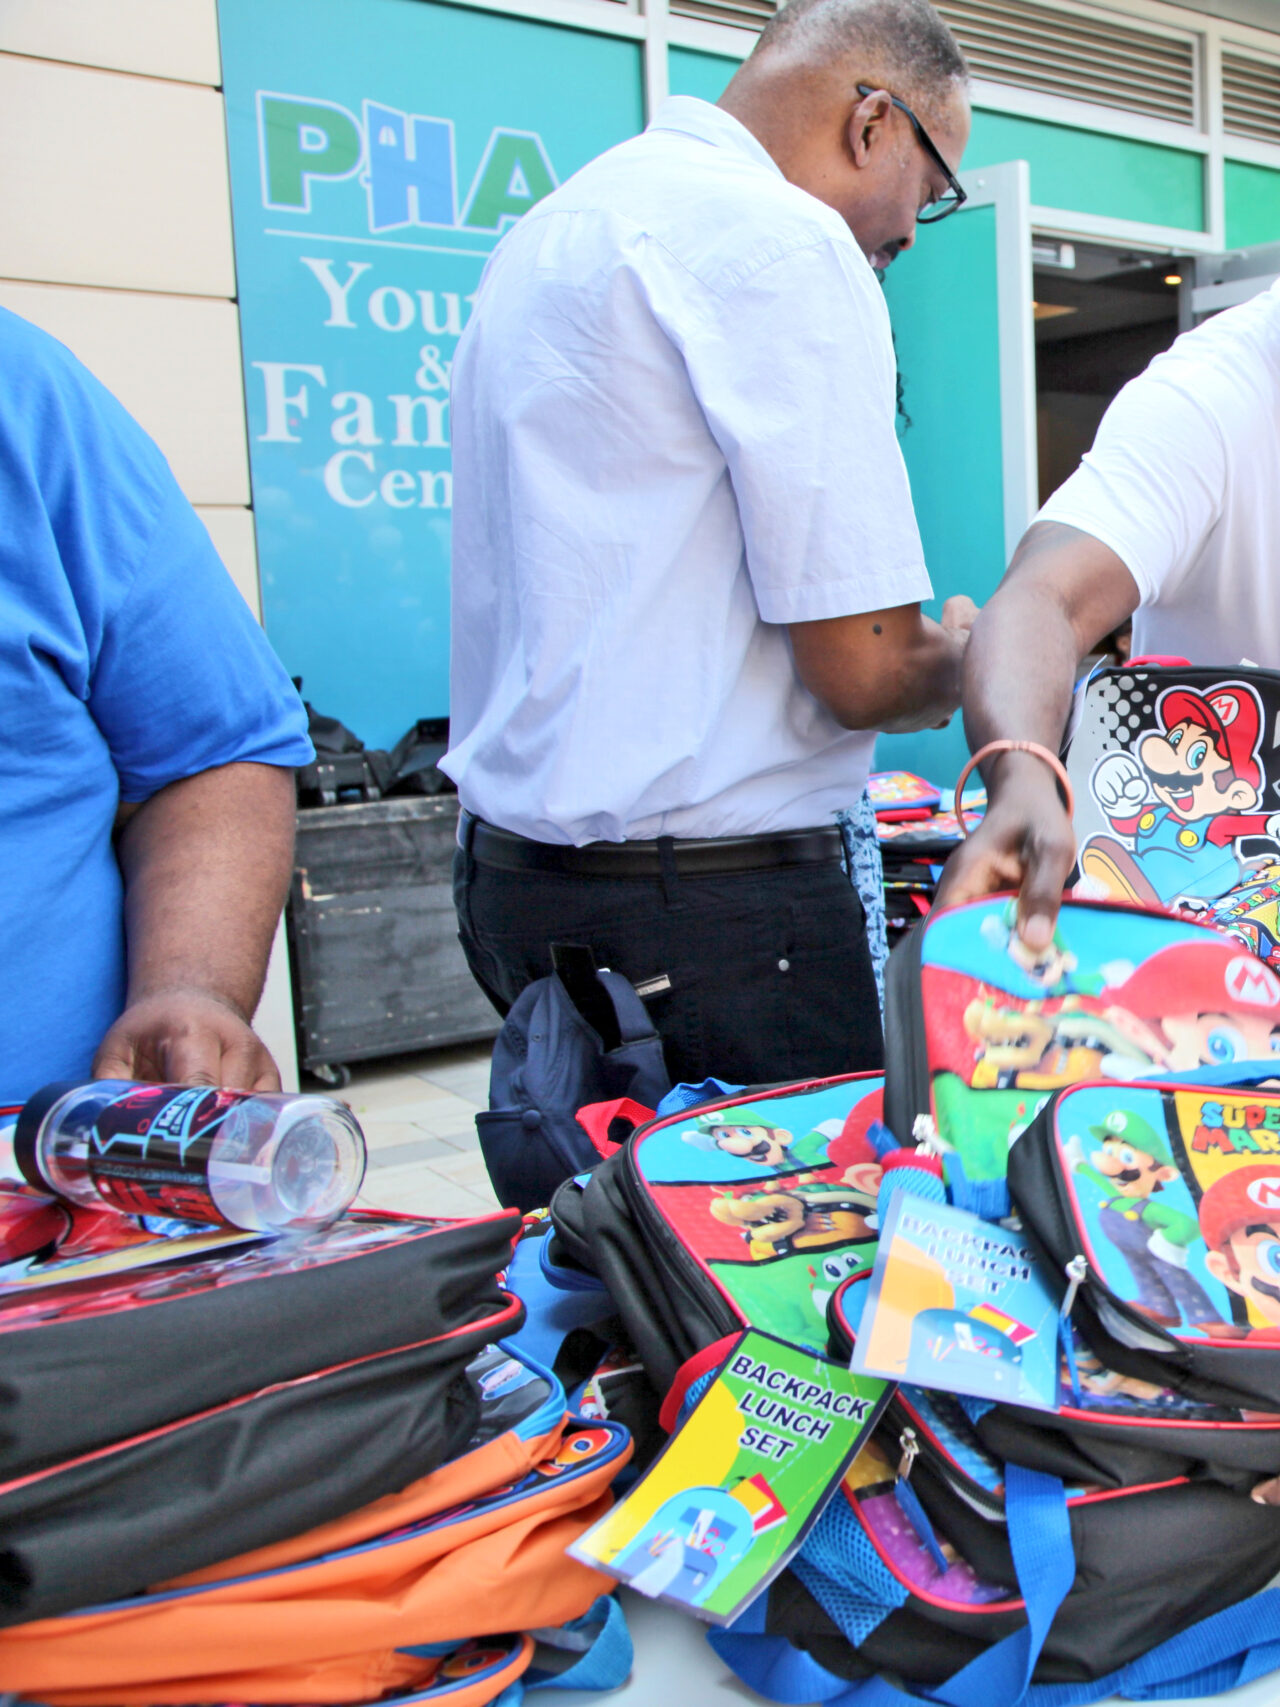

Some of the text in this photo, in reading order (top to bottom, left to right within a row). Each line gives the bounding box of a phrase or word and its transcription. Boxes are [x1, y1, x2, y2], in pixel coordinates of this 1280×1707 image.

[256, 90, 560, 235] PHA
[415, 344, 451, 391] &
[926, 1240, 1032, 1283] LUNCH
[944, 1268, 1006, 1296] SET
[730, 1354, 872, 1421] BACKPACK
[738, 1392, 832, 1441] LUNCH
[739, 1427, 795, 1459] SET
